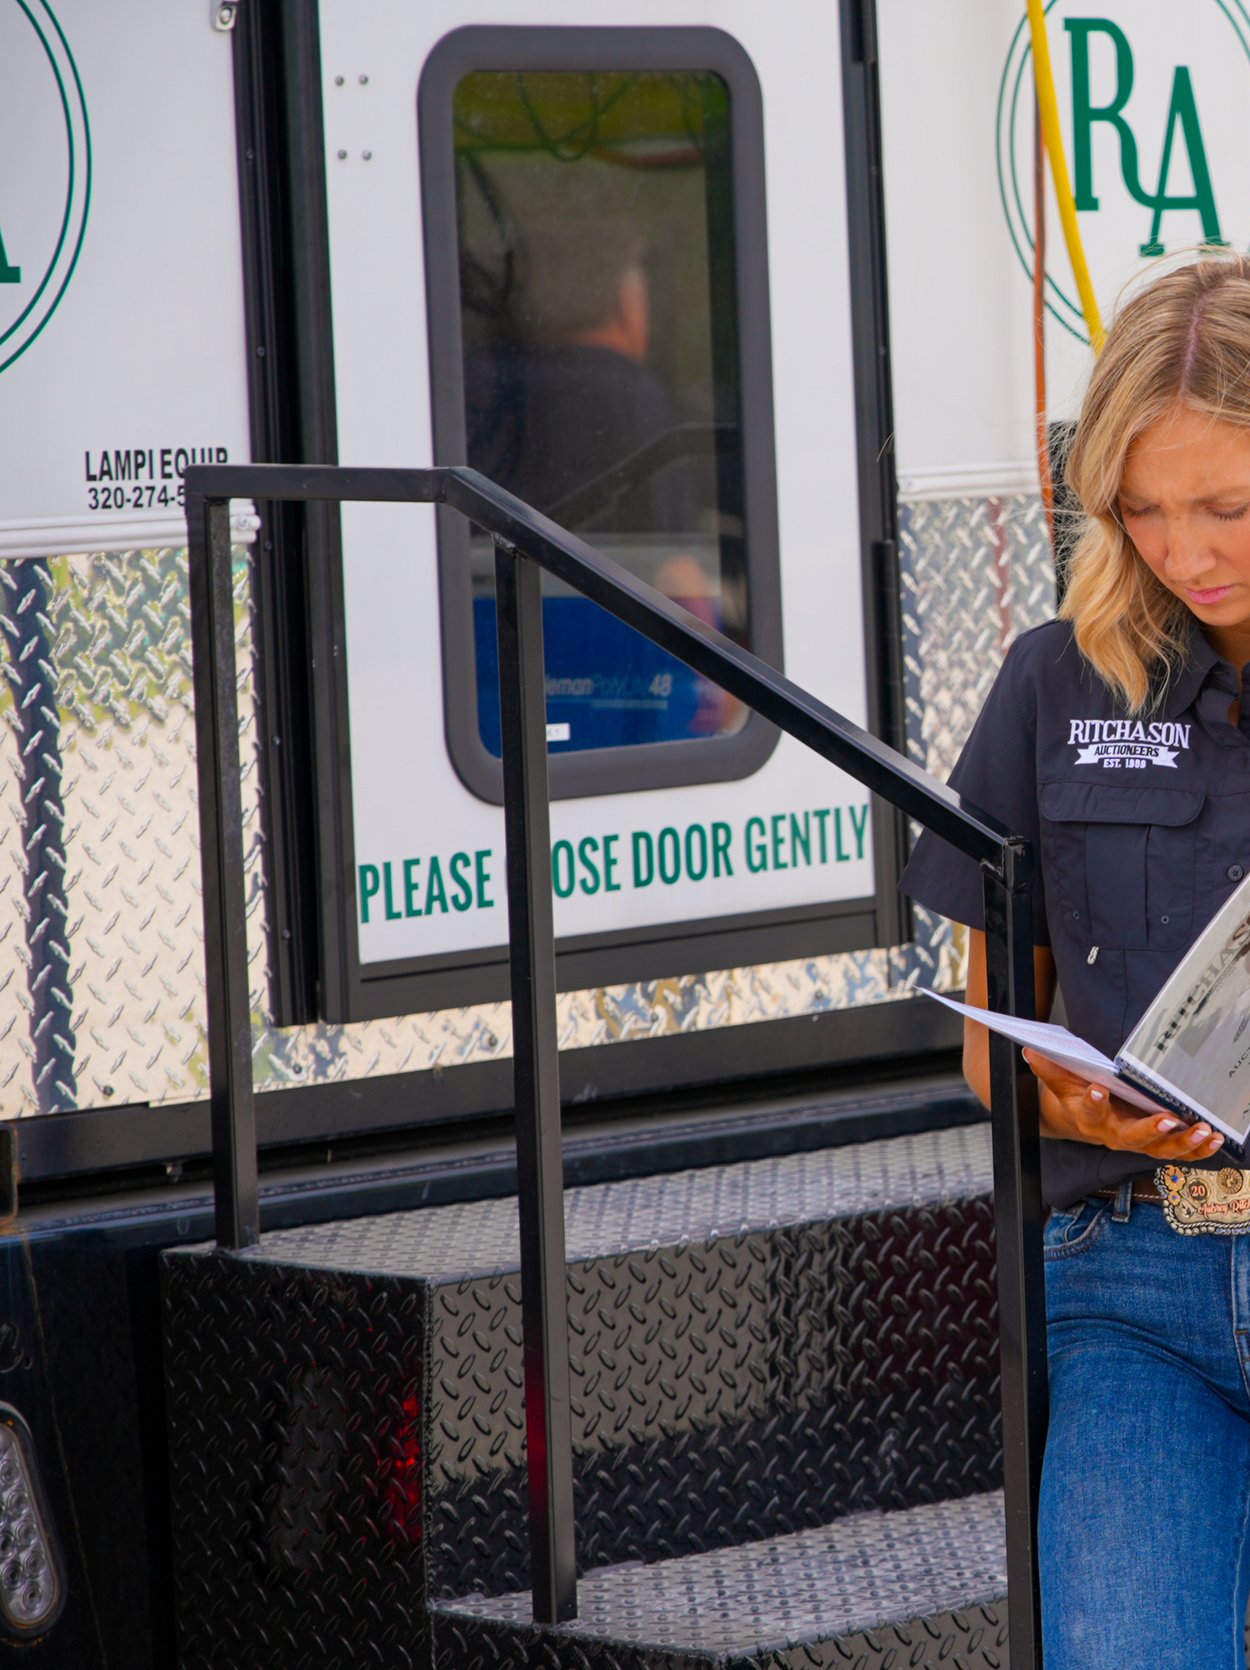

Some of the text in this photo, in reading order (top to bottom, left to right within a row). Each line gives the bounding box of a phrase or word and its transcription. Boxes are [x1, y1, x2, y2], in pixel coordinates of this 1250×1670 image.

[85, 449, 154, 481] LAMPI
[88, 485, 185, 509] 320-274-5
[648, 673, 673, 696] 48
[1067, 719, 1191, 749] RITCHASON
[1094, 744, 1160, 757] AUCTIONEERS
[358, 803, 870, 923] PLEASE OSE DOOR GENTLY
[1190, 1185, 1206, 1197] 20
